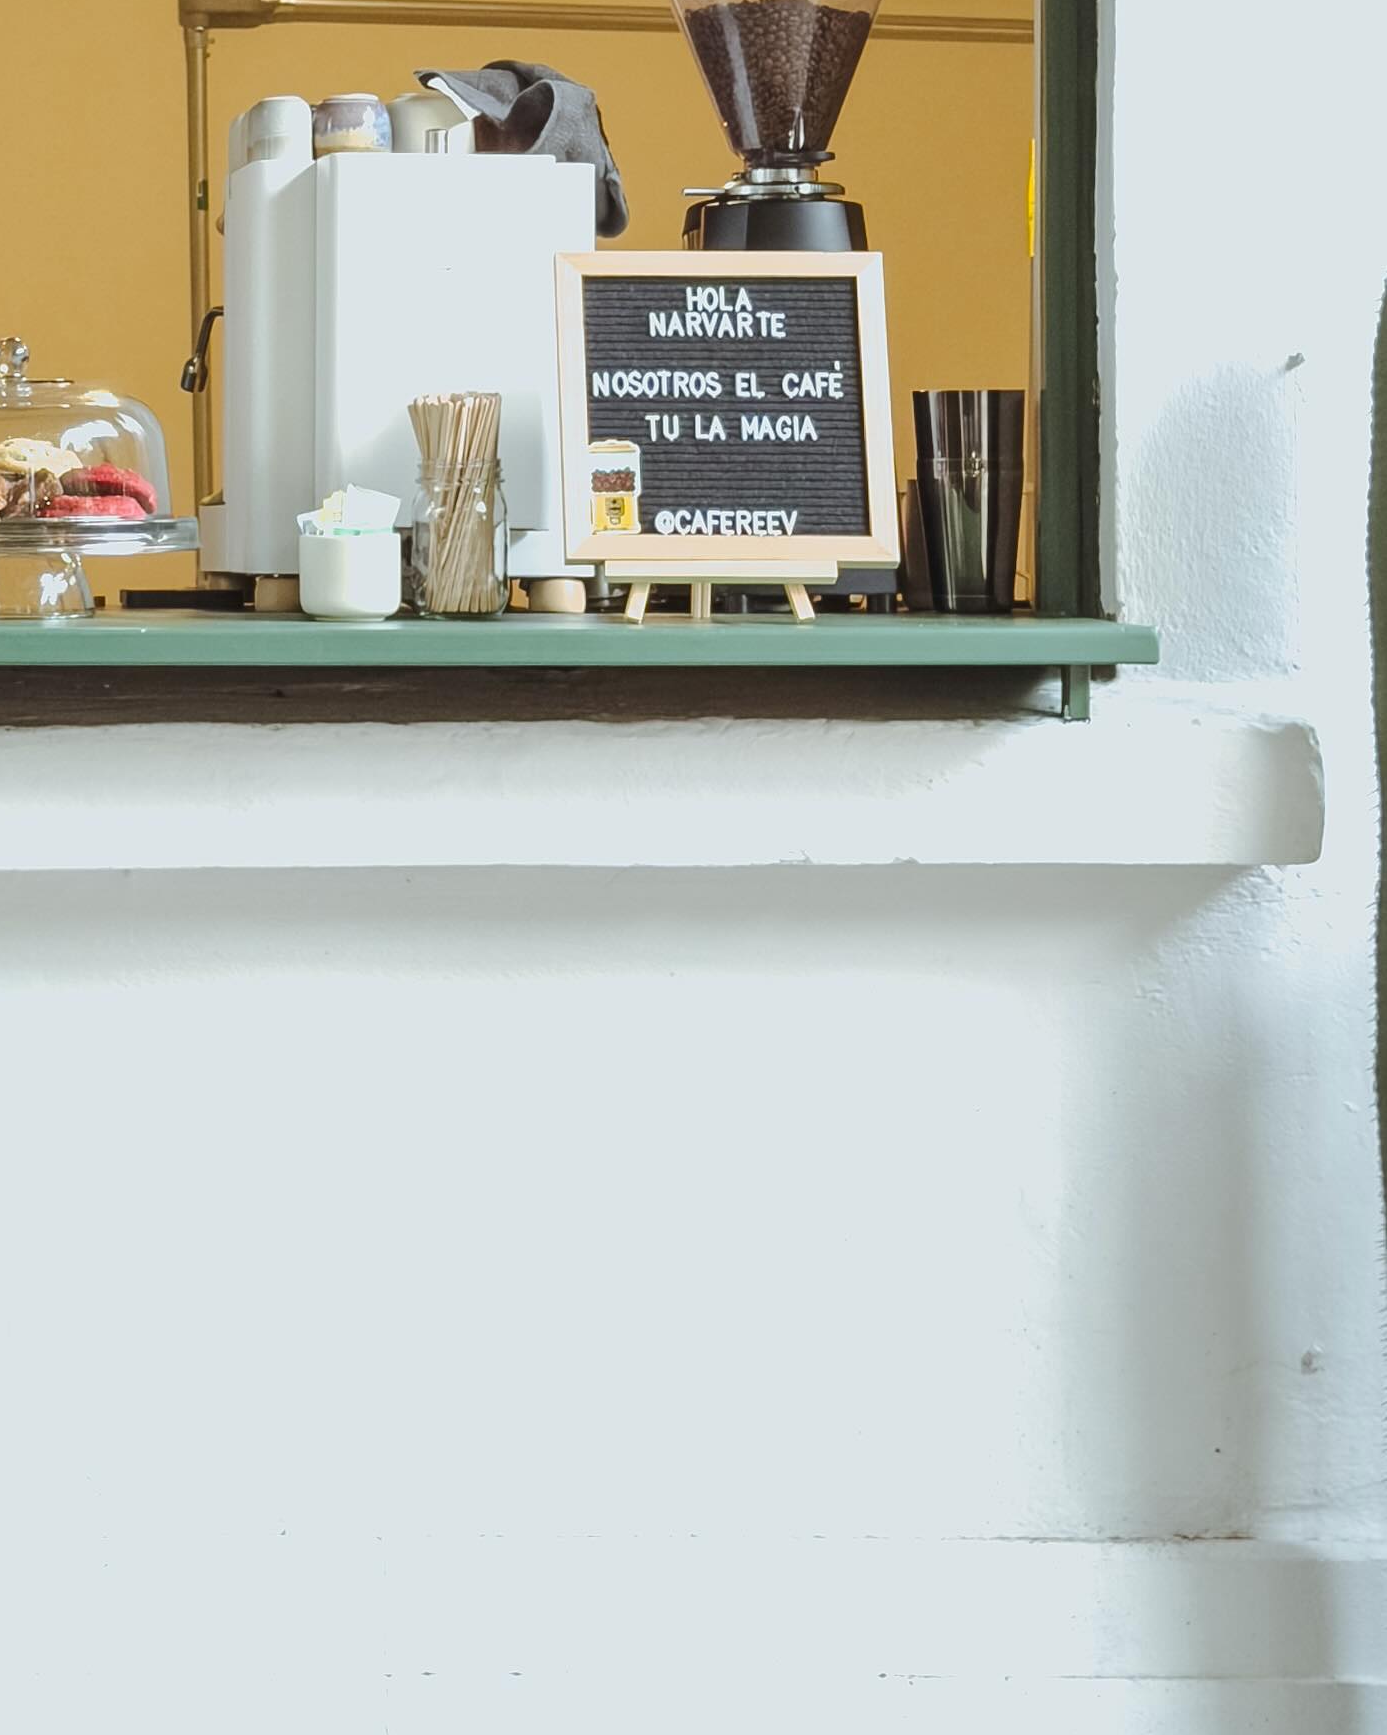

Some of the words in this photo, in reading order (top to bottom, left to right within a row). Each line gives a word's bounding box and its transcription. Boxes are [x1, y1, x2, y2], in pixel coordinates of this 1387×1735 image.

[686, 286, 752, 311] HOLA
[648, 311, 787, 338] NARVARTE
[592, 370, 722, 398] NOSOTROS
[735, 372, 765, 398] EL
[645, 414, 679, 442] TU
[694, 414, 726, 441] LA
[740, 414, 818, 442] MAGIA
[653, 509, 798, 536] @CAFEREEV
